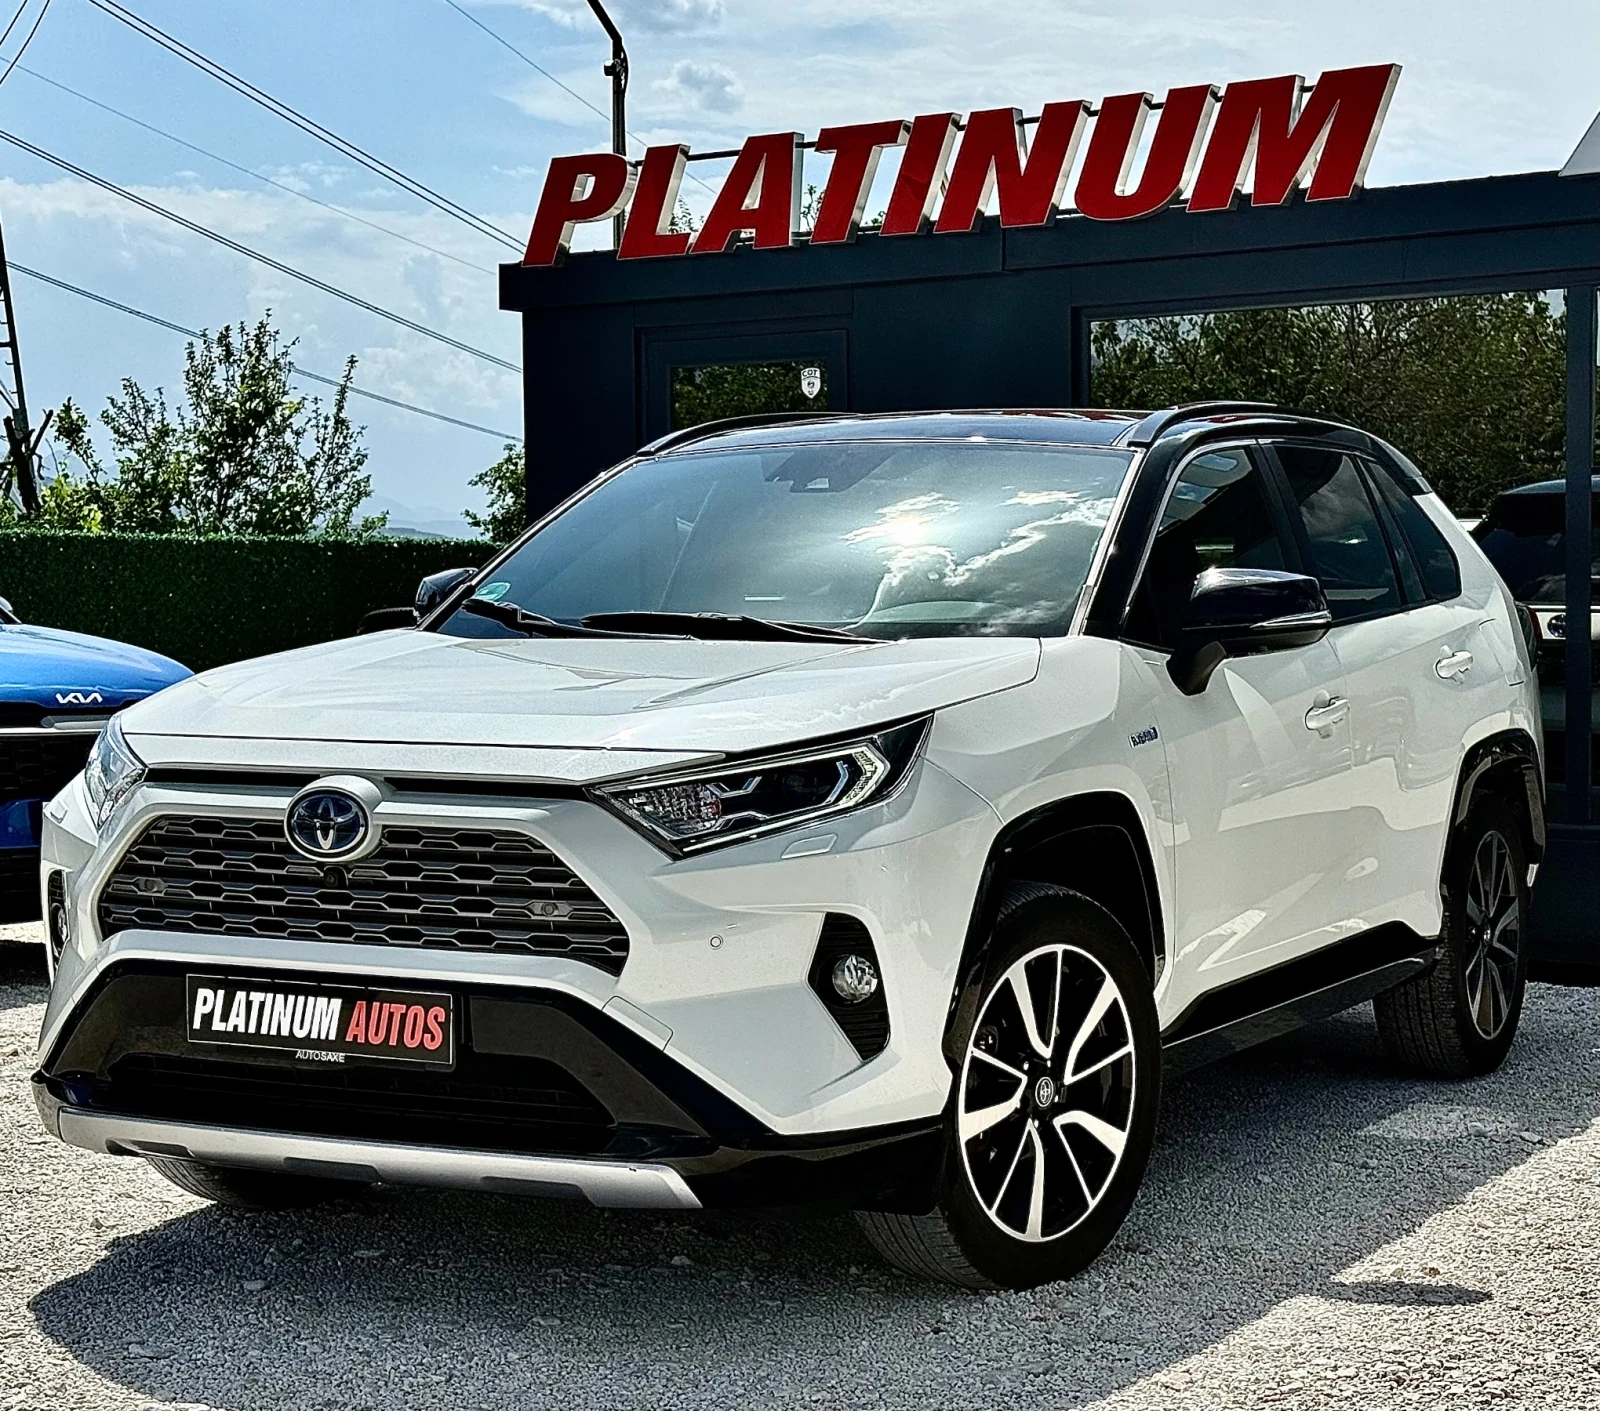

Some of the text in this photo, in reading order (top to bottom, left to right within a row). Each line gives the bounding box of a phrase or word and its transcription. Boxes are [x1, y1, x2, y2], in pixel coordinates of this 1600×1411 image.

[523, 64, 1402, 268] PLATINUM
[193, 988, 446, 1050] PLATINUM AUTOS
[295, 1050, 346, 1063] AUTOSAXE
